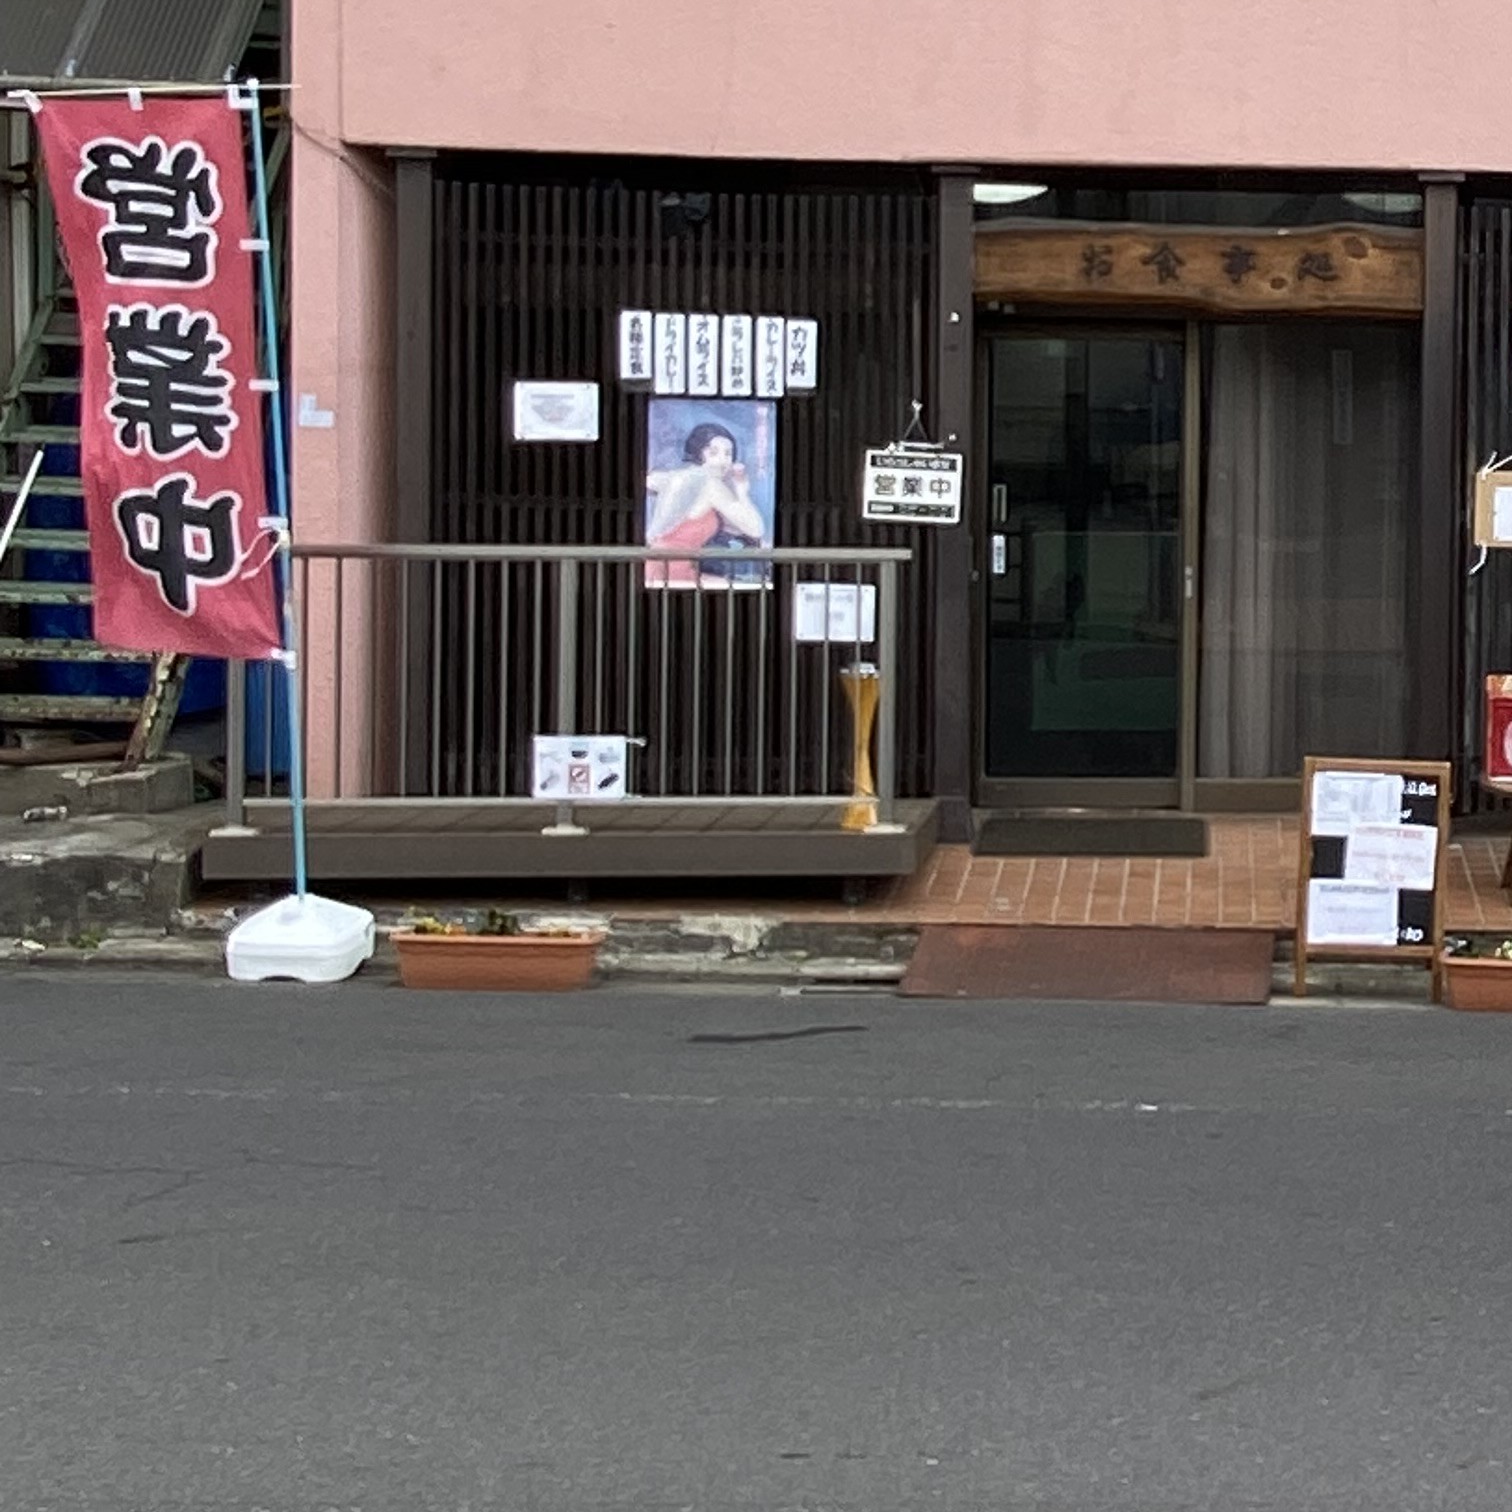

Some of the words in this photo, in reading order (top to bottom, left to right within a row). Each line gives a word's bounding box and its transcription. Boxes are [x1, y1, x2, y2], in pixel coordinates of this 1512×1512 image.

[1079, 241, 1340, 285] お食事処
[696, 316, 711, 387] オムライス
[791, 325, 808, 377] カツ丼
[874, 474, 952, 499] 営業中
